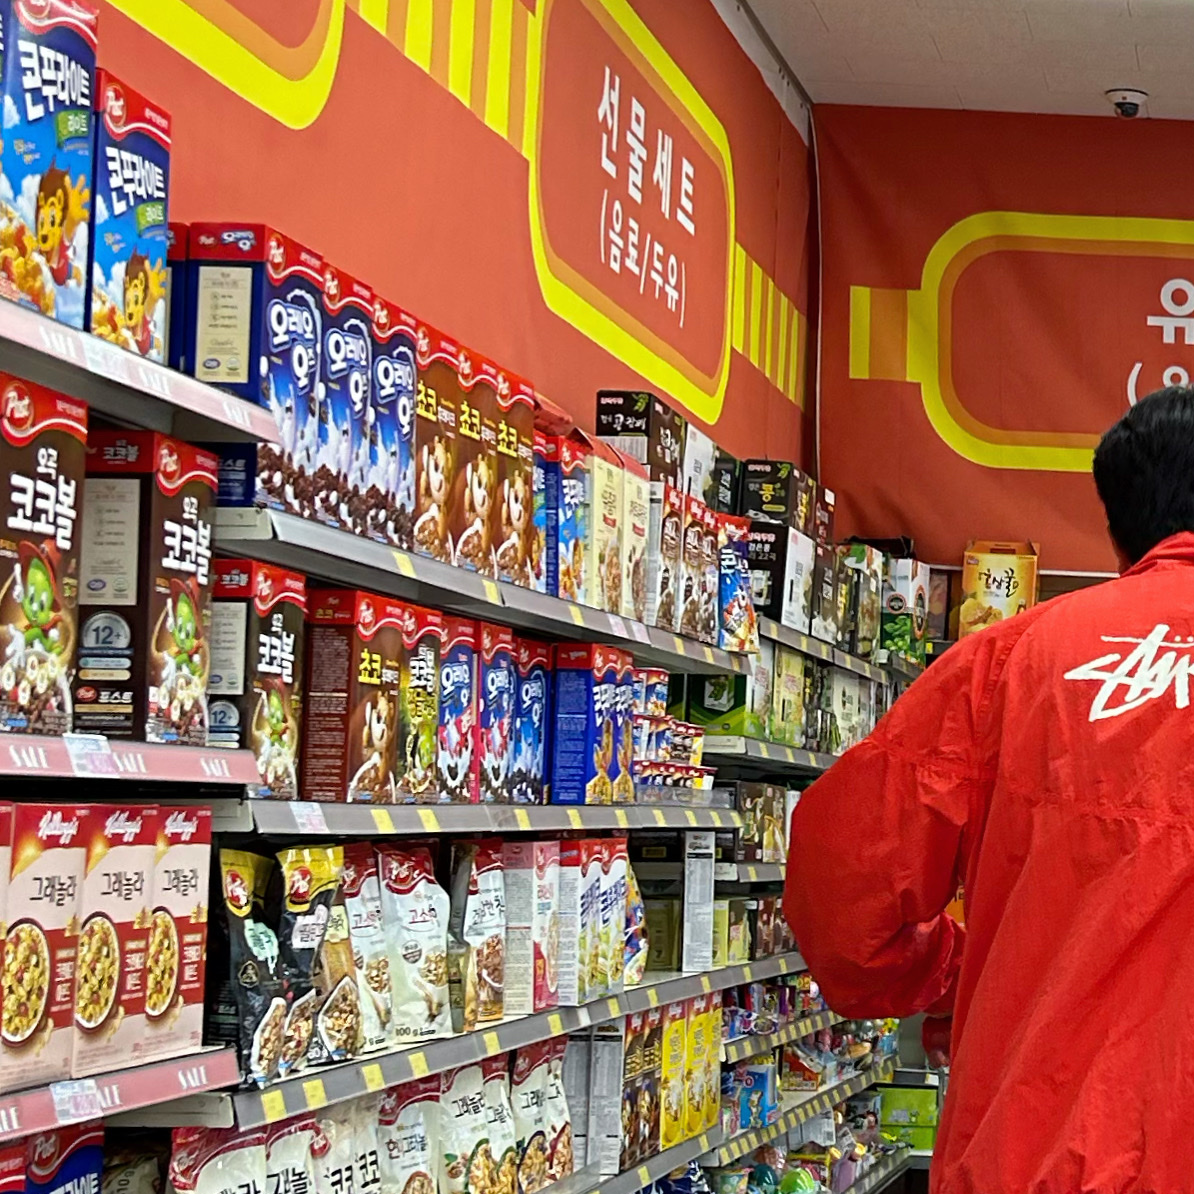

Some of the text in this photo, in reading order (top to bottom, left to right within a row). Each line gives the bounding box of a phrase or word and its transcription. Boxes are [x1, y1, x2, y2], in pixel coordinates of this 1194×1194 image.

[18, 40, 91, 121] 콘푸라이트
[597, 65, 695, 236] 선물세트
[106, 147, 166, 216] 콘푸라이트
[600, 189, 686, 328] (음료/두유)
[416, 380, 437, 421] 초코
[460, 400, 481, 441] 초코
[498, 420, 518, 457] 초코
[8, 473, 76, 550] 코코볼
[161, 520, 211, 585] 코코볼
[92, 627, 123, 646] 12+
[257, 630, 295, 684] 코코볼
[358, 648, 381, 684] 초코
[30, 876, 77, 906] 그래놀라
[101, 871, 145, 900] 그래놀라
[162, 869, 200, 896] 그래놀라
